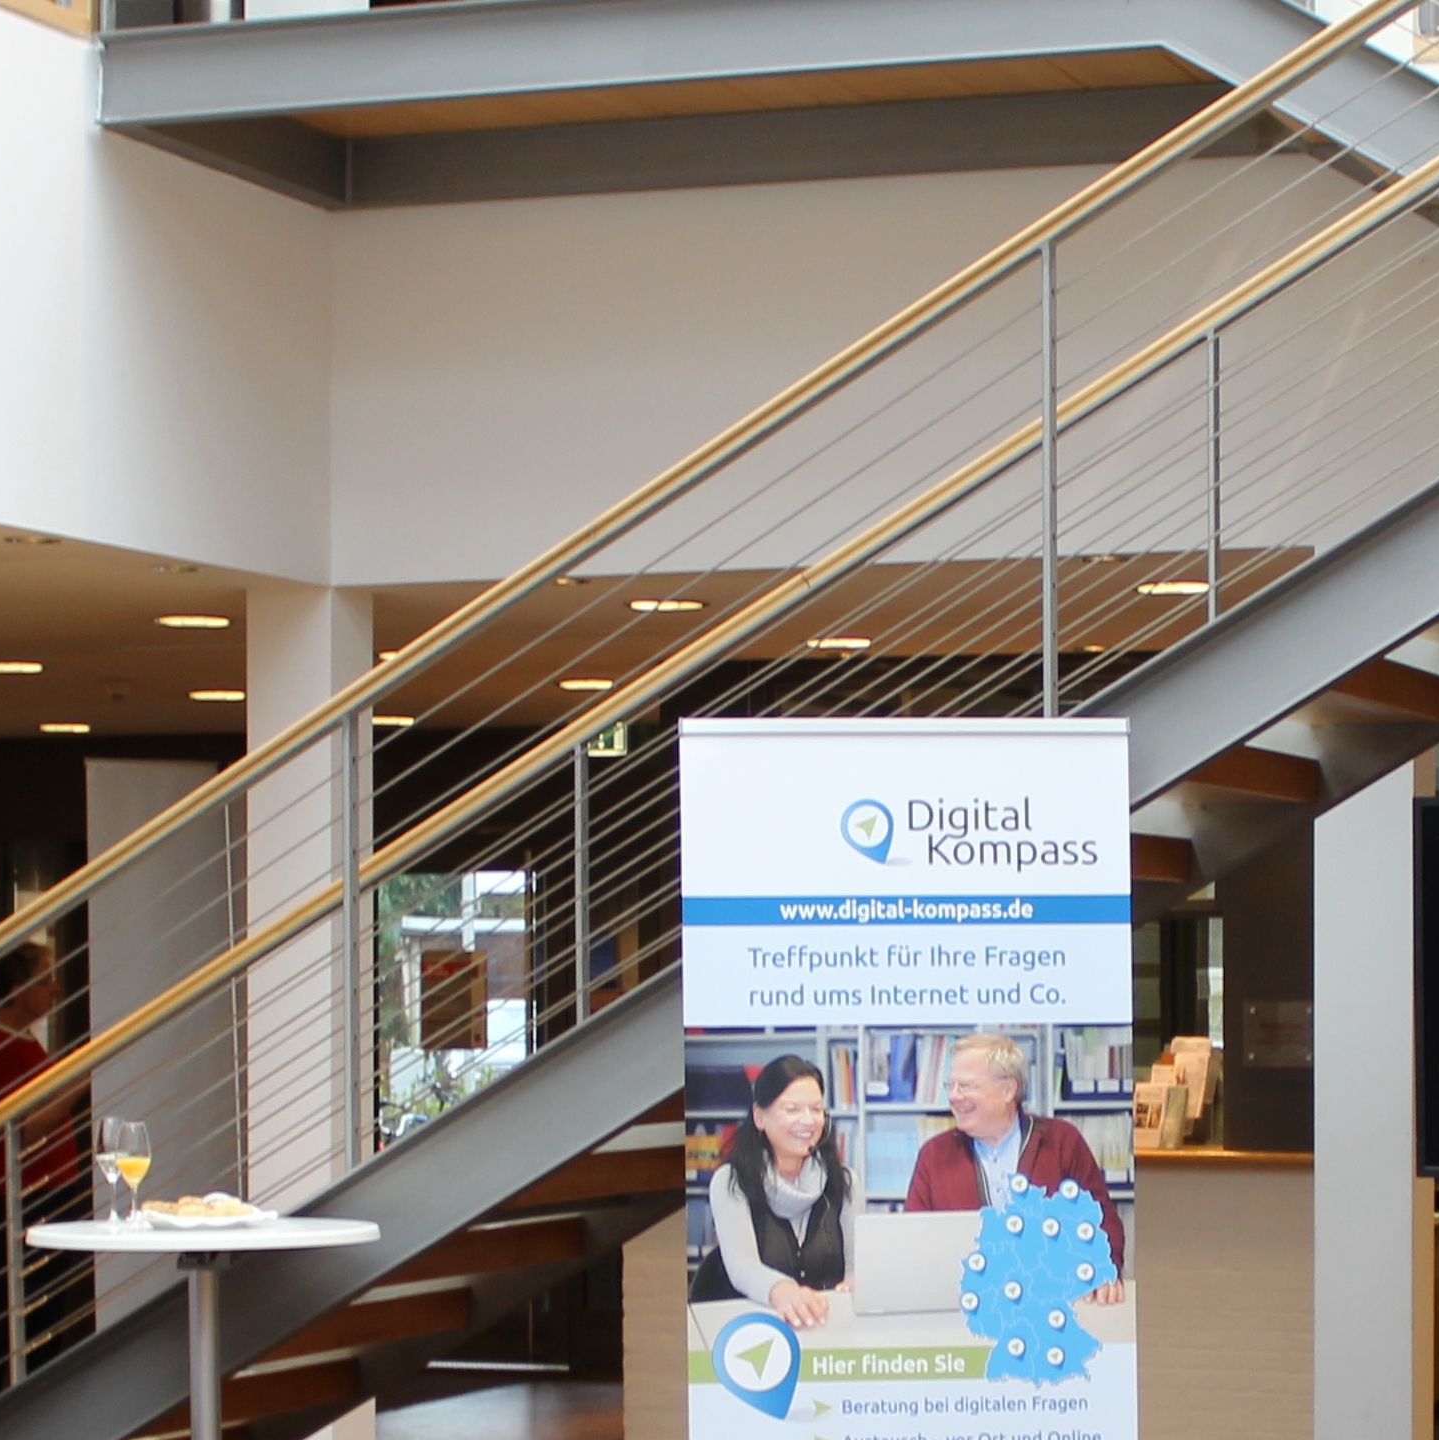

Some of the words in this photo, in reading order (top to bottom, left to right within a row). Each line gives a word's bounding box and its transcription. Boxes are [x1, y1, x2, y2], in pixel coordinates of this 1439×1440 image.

[908, 797, 1032, 838] Digital
[927, 834, 1098, 872] Kompass
[779, 900, 1033, 923] www.digital-kompass.de
[748, 945, 879, 971] Treffpunkt
[887, 945, 922, 968] für
[931, 946, 976, 968] Ihre
[985, 946, 1066, 972] Fragen
[749, 984, 804, 1007] rund
[814, 988, 862, 1006] ums
[871, 984, 969, 1006] Internet
[977, 984, 1021, 1005] und
[1030, 984, 1066, 1005] Co.
[812, 1355, 856, 1376] Hier
[862, 1354, 929, 1375] finden
[934, 1353, 965, 1374] Sie
[841, 1398, 918, 1417] Beratung
[924, 1398, 949, 1414] bei
[954, 1396, 1027, 1416] digitalen
[1032, 1396, 1088, 1415] Fragen
